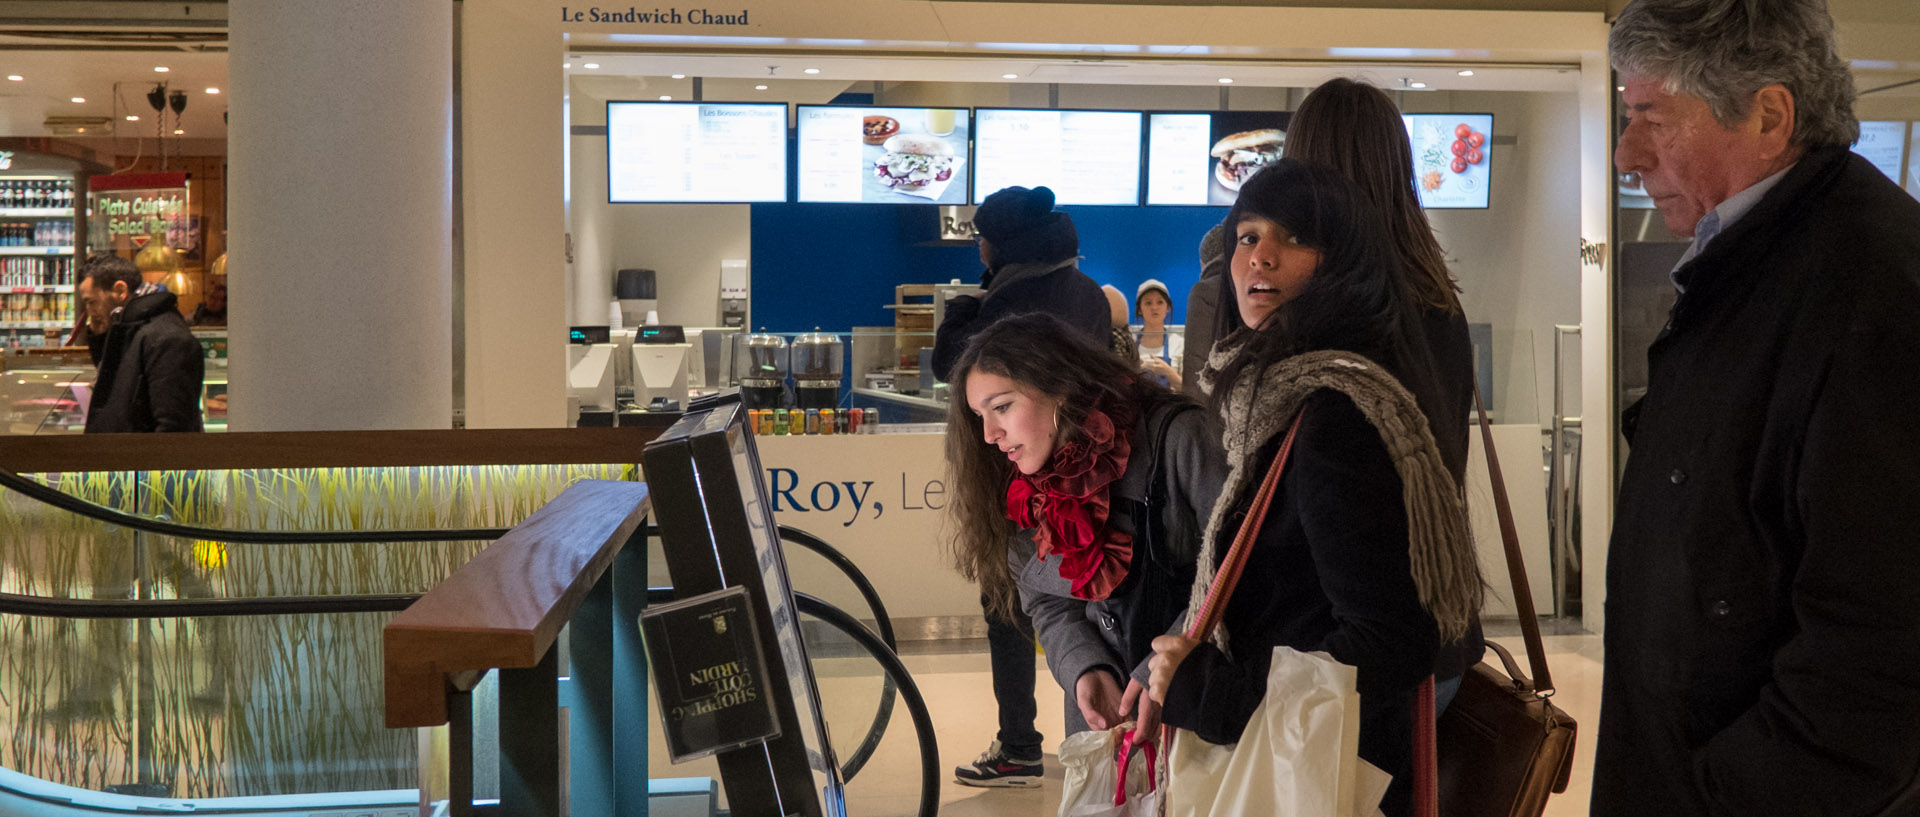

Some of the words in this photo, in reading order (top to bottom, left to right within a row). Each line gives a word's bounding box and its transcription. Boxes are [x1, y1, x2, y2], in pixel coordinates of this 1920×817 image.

[561, 7, 584, 22] Le
[589, 7, 682, 24] Sandwich
[687, 9, 749, 25] Chaud
[100, 197, 130, 216] Plats
[766, 468, 883, 527] Roy,
